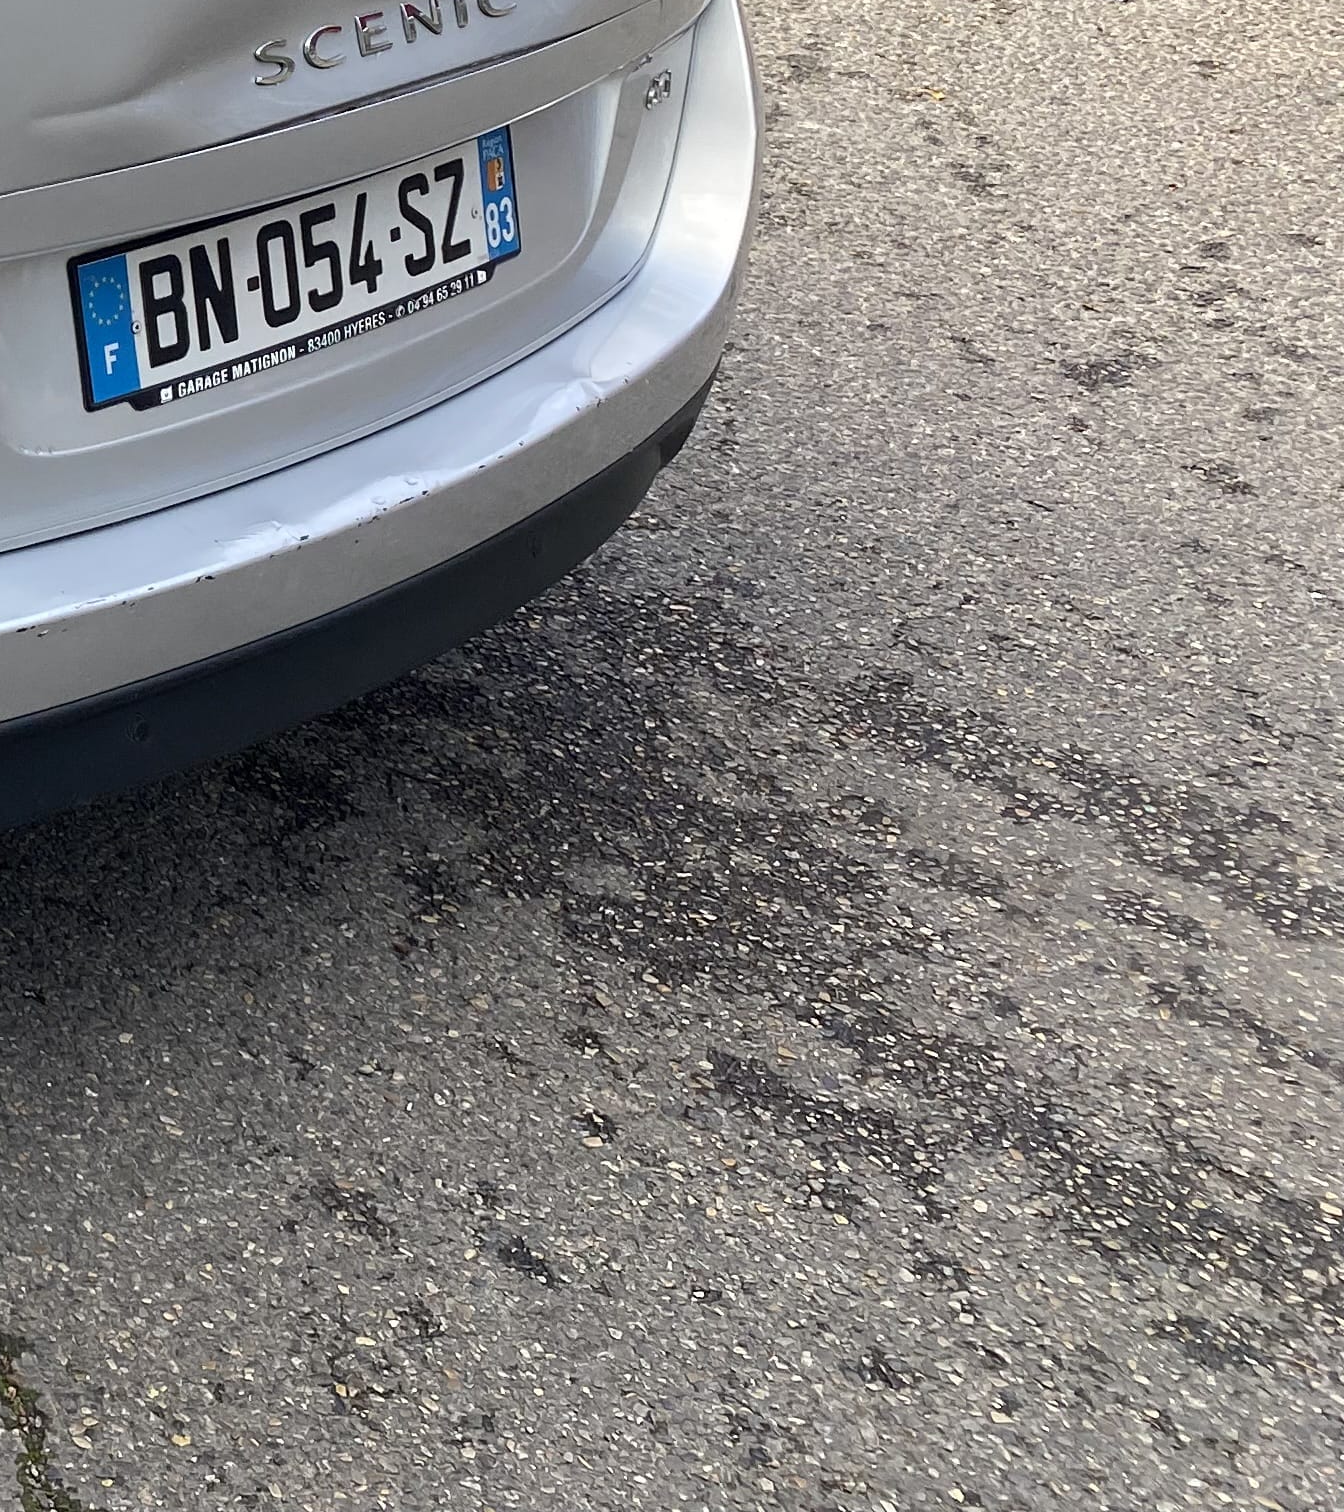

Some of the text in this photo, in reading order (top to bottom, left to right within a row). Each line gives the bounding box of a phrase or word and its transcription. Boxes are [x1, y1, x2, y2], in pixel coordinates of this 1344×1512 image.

[138, 158, 472, 369] BN-054-SZ
[484, 196, 516, 248] 83
[104, 343, 118, 375] F
[178, 368, 229, 398] GARAGE
[232, 344, 297, 381] MATIGNON
[308, 328, 342, 353] 83400
[408, 298, 421, 315] 04
[422, 291, 434, 308] 94
[436, 287, 448, 302] 65
[450, 279, 462, 296] 29
[465, 273, 475, 289] 11
